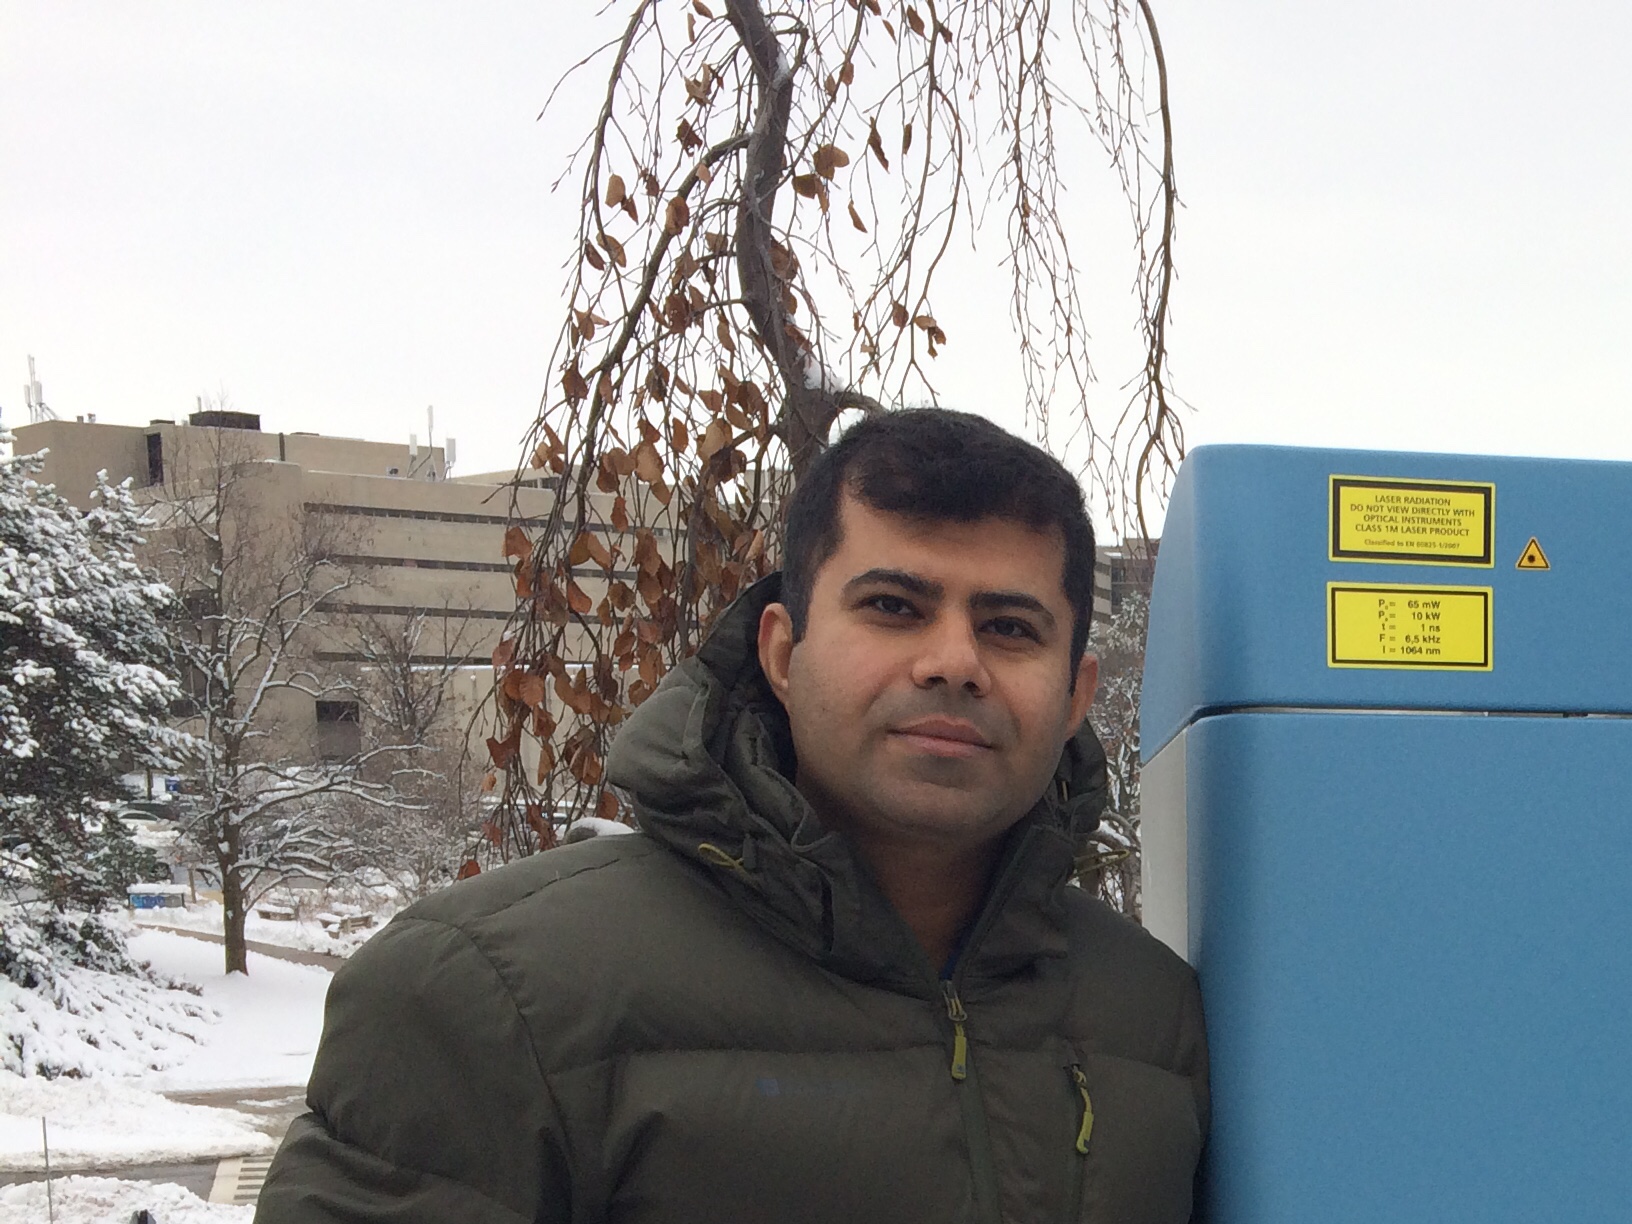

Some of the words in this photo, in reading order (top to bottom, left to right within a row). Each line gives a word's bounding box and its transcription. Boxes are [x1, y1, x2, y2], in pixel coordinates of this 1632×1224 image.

[1375, 495, 1401, 503] LASER
[1404, 496, 1450, 506] RADIATION
[1350, 503, 1363, 511] DO
[1366, 504, 1384, 512] NOT
[1387, 505, 1409, 513] VIEW
[1412, 507, 1450, 515] DIRECTLY
[1453, 509, 1475, 517] WITH
[1363, 514, 1399, 523] OPTICAL
[1401, 515, 1462, 526] INSTRUMENTS
[1355, 523, 1382, 532] CLASS
[1385, 525, 1398, 533] 1M
[1401, 526, 1427, 534] LASER
[1430, 528, 1469, 537] PRODUCT
[1408, 600, 1419, 608] 65
[1422, 601, 1440, 609] mW
[1412, 612, 1423, 620] 10
[1426, 612, 1440, 620] kW
[1422, 624, 1425, 632] 1
[1380, 634, 1385, 642] F
[1405, 635, 1420, 644] 6,5
[1423, 635, 1440, 644] kHz
[1401, 646, 1422, 654] 1064
